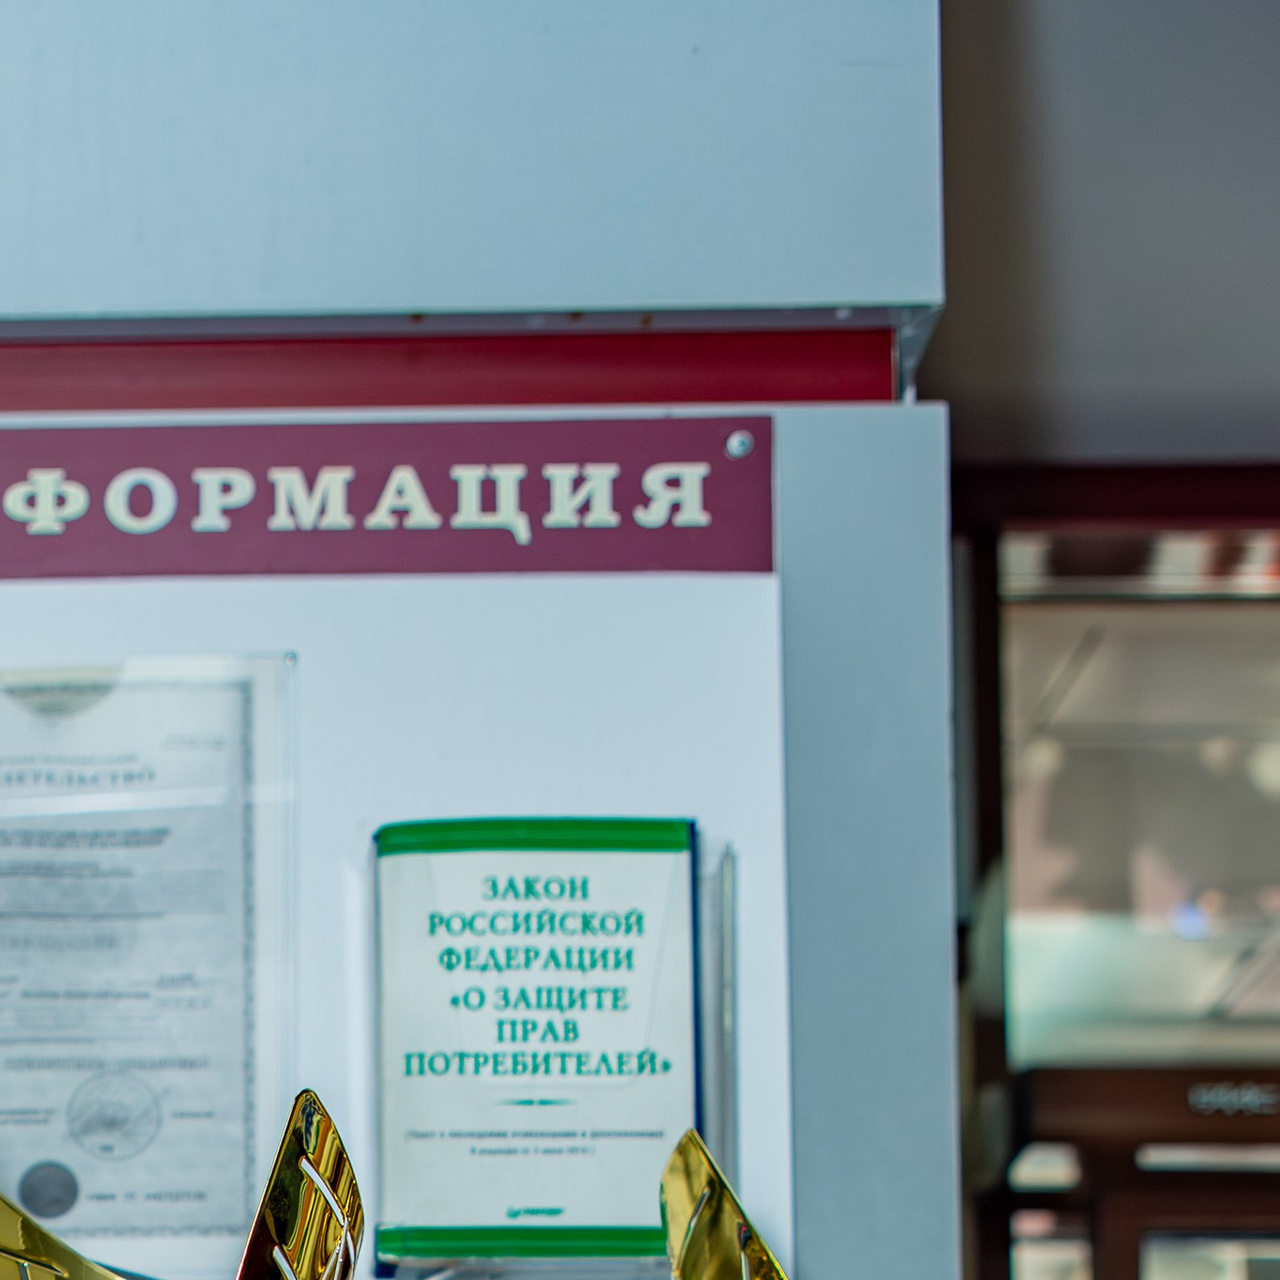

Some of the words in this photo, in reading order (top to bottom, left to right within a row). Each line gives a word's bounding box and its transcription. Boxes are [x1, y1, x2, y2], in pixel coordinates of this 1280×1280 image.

[482, 876, 589, 900] ЗАКОН
[428, 908, 644, 936] РОССИЙСКОЙ
[439, 947, 634, 973] ФЕДЕРАЦИИ
[450, 987, 486, 1010] «О
[494, 987, 629, 1014] ЗАЩИТЕ
[496, 1019, 578, 1042] ПРАВ
[403, 1048, 672, 1077] ПОТРЕБИТЕЛЕЙ»
